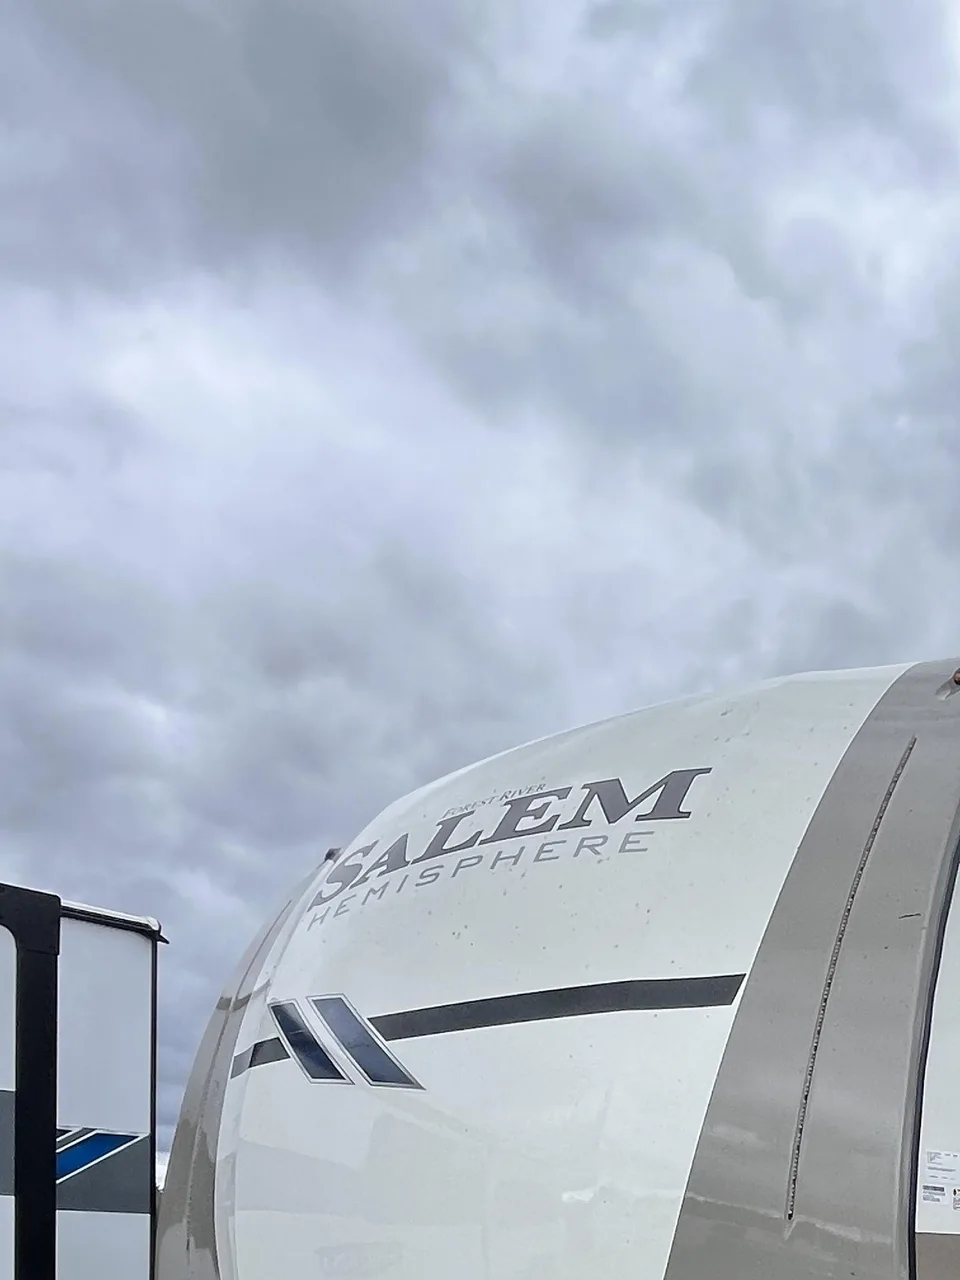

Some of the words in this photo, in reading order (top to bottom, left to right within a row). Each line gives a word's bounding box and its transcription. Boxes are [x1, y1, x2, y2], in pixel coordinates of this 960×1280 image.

[306, 766, 713, 912] SALEM
[441, 795, 498, 819] FOREST
[500, 783, 546, 801] RIVER
[306, 830, 656, 931] HEMISPHERE
